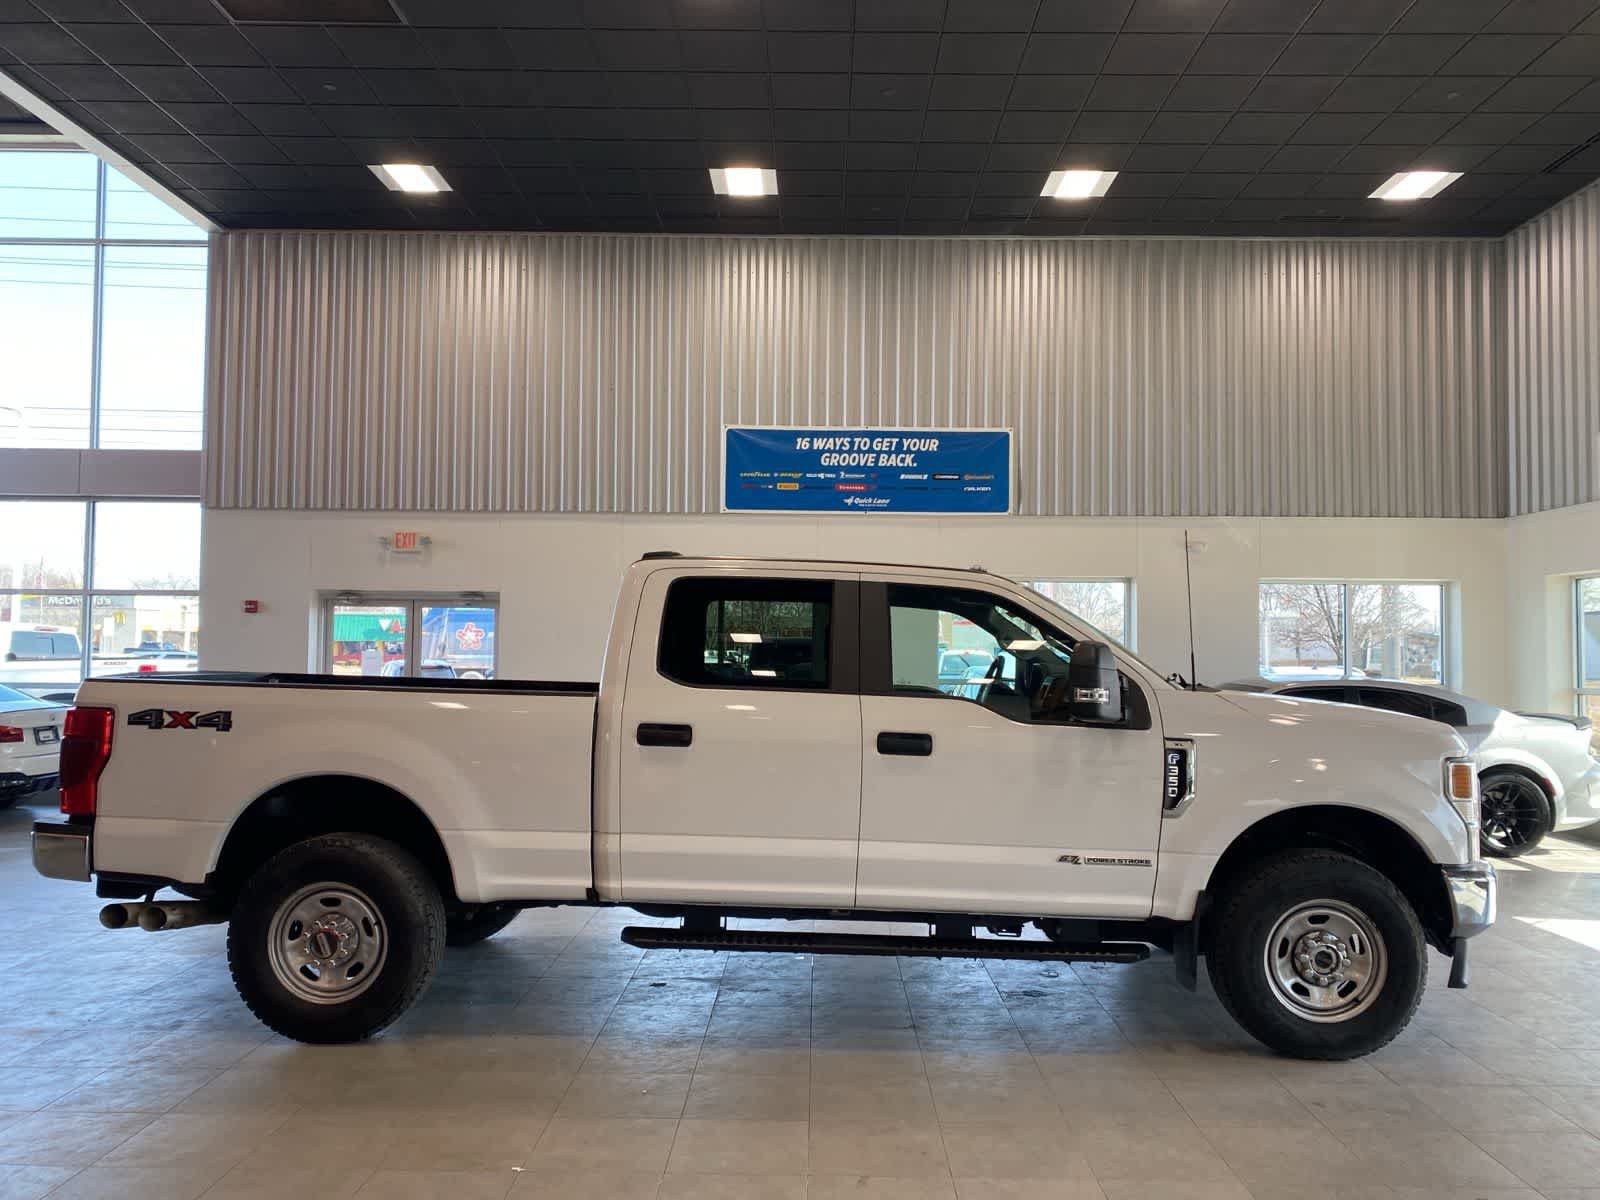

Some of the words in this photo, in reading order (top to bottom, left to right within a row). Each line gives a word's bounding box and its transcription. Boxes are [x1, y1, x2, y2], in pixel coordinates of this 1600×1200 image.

[795, 437, 809, 451] 16
[813, 437, 851, 451] WAYS
[853, 437, 870, 451] TO
[872, 437, 899, 451] GET
[902, 438, 940, 452] YOUR
[820, 453, 877, 466] GROOVE
[878, 453, 918, 467] BACK.
[395, 532, 417, 549] EXIT
